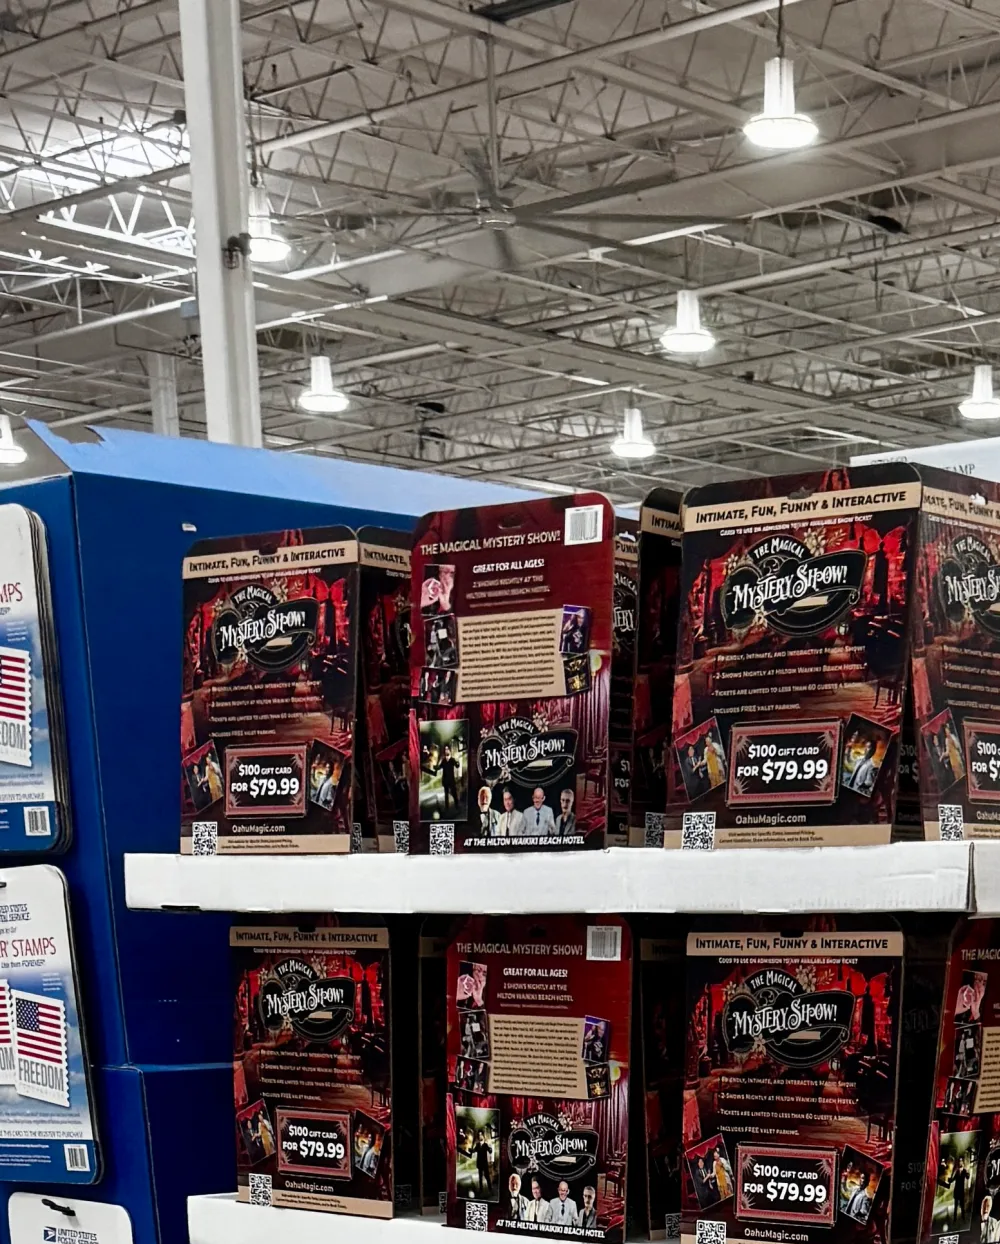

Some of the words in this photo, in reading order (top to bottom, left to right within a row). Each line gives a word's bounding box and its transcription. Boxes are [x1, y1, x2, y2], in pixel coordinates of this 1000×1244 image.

[696, 509, 748, 524] INTIMATE,
[751, 505, 777, 518] FUN,
[780, 500, 818, 514] FUNNY
[821, 498, 829, 509] &
[832, 491, 907, 508] INTERACTIVE
[420, 543, 438, 556] THE
[439, 539, 482, 554] MAGICAL
[483, 534, 526, 549] MYSTERY
[527, 530, 561, 544] SHOW!
[753, 545, 770, 559] THE
[770, 537, 805, 558] MAGICAL
[472, 561, 496, 573] GREAT
[495, 560, 511, 571] FOR
[510, 559, 524, 570] ALL
[732, 574, 796, 614] MYSTERY
[796, 563, 848, 598] SHOW!
[748, 744, 777, 760] $100
[778, 748, 796, 757] GIFT
[796, 747, 819, 755] CARD
[238, 764, 260, 777] $100
[261, 767, 274, 776] GIFT
[275, 766, 292, 775] CARD
[737, 766, 759, 777] FOR
[761, 758, 829, 784] $79.99
[231, 782, 248, 793] FOR
[250, 777, 300, 798] $79.99
[735, 812, 807, 826] OahuMagic.com
[463, 838, 473, 847] AT
[473, 837, 486, 846] THE
[487, 837, 511, 846] HILTON
[511, 836, 538, 845] WAIKIKI
[539, 836, 561, 845] BEACH
[562, 835, 585, 845] HOTEL
[12, 937, 57, 957] STAMPS
[695, 937, 743, 951] INTIMATE,
[746, 938, 770, 950] FUN,
[773, 937, 808, 949] FUNNY
[811, 938, 818, 949] &
[820, 937, 889, 949] INTERACTIVE
[750, 977, 764, 990] THE
[766, 971, 798, 993] MAGICAL
[732, 1004, 790, 1037] MYSTERY
[788, 998, 837, 1029] SHOW!
[18, 1058, 64, 1092] FREEDOM
[753, 1163, 779, 1177] $100
[780, 1170, 796, 1178] GIFT
[797, 1171, 818, 1180] CARD
[744, 1182, 763, 1194] FOR
[766, 1178, 827, 1203] $79.99
[57, 1228, 78, 1239] UNITED
[744, 1227, 809, 1241] OahuMagic.com
